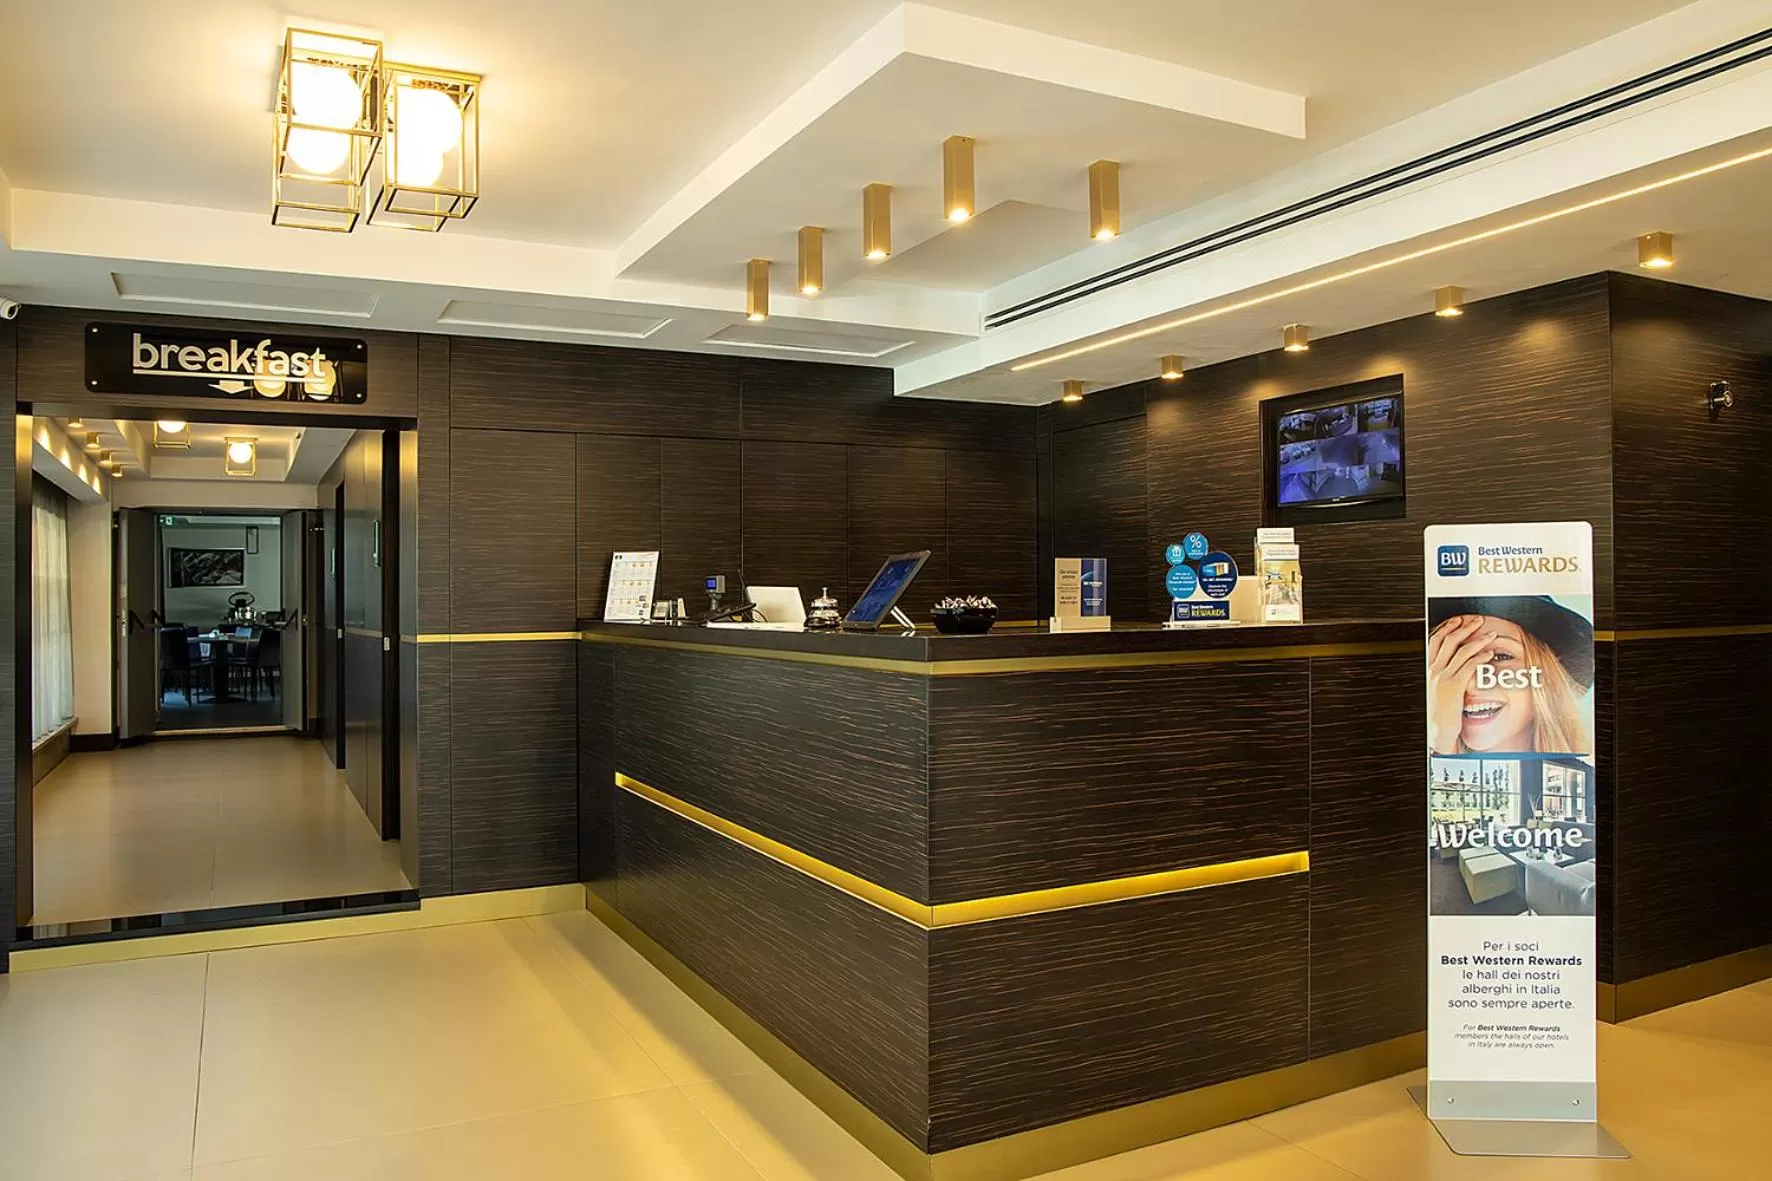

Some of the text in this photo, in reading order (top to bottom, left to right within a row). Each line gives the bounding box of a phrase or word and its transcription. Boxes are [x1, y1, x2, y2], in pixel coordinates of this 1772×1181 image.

[132, 333, 327, 377] breakfast
[1478, 546, 1543, 555] Best Western
[1441, 553, 1466, 565] BW
[1476, 664, 1543, 689] Best
[1483, 941, 1503, 951] Per
[1515, 941, 1539, 951] soci
[1441, 956, 1582, 966] Best Western Rewards
[1463, 970, 1560, 980] le hall dei nostri
[1462, 984, 1560, 996] alberghi in Italia
[1448, 999, 1575, 1010] sono sempre aperte.
